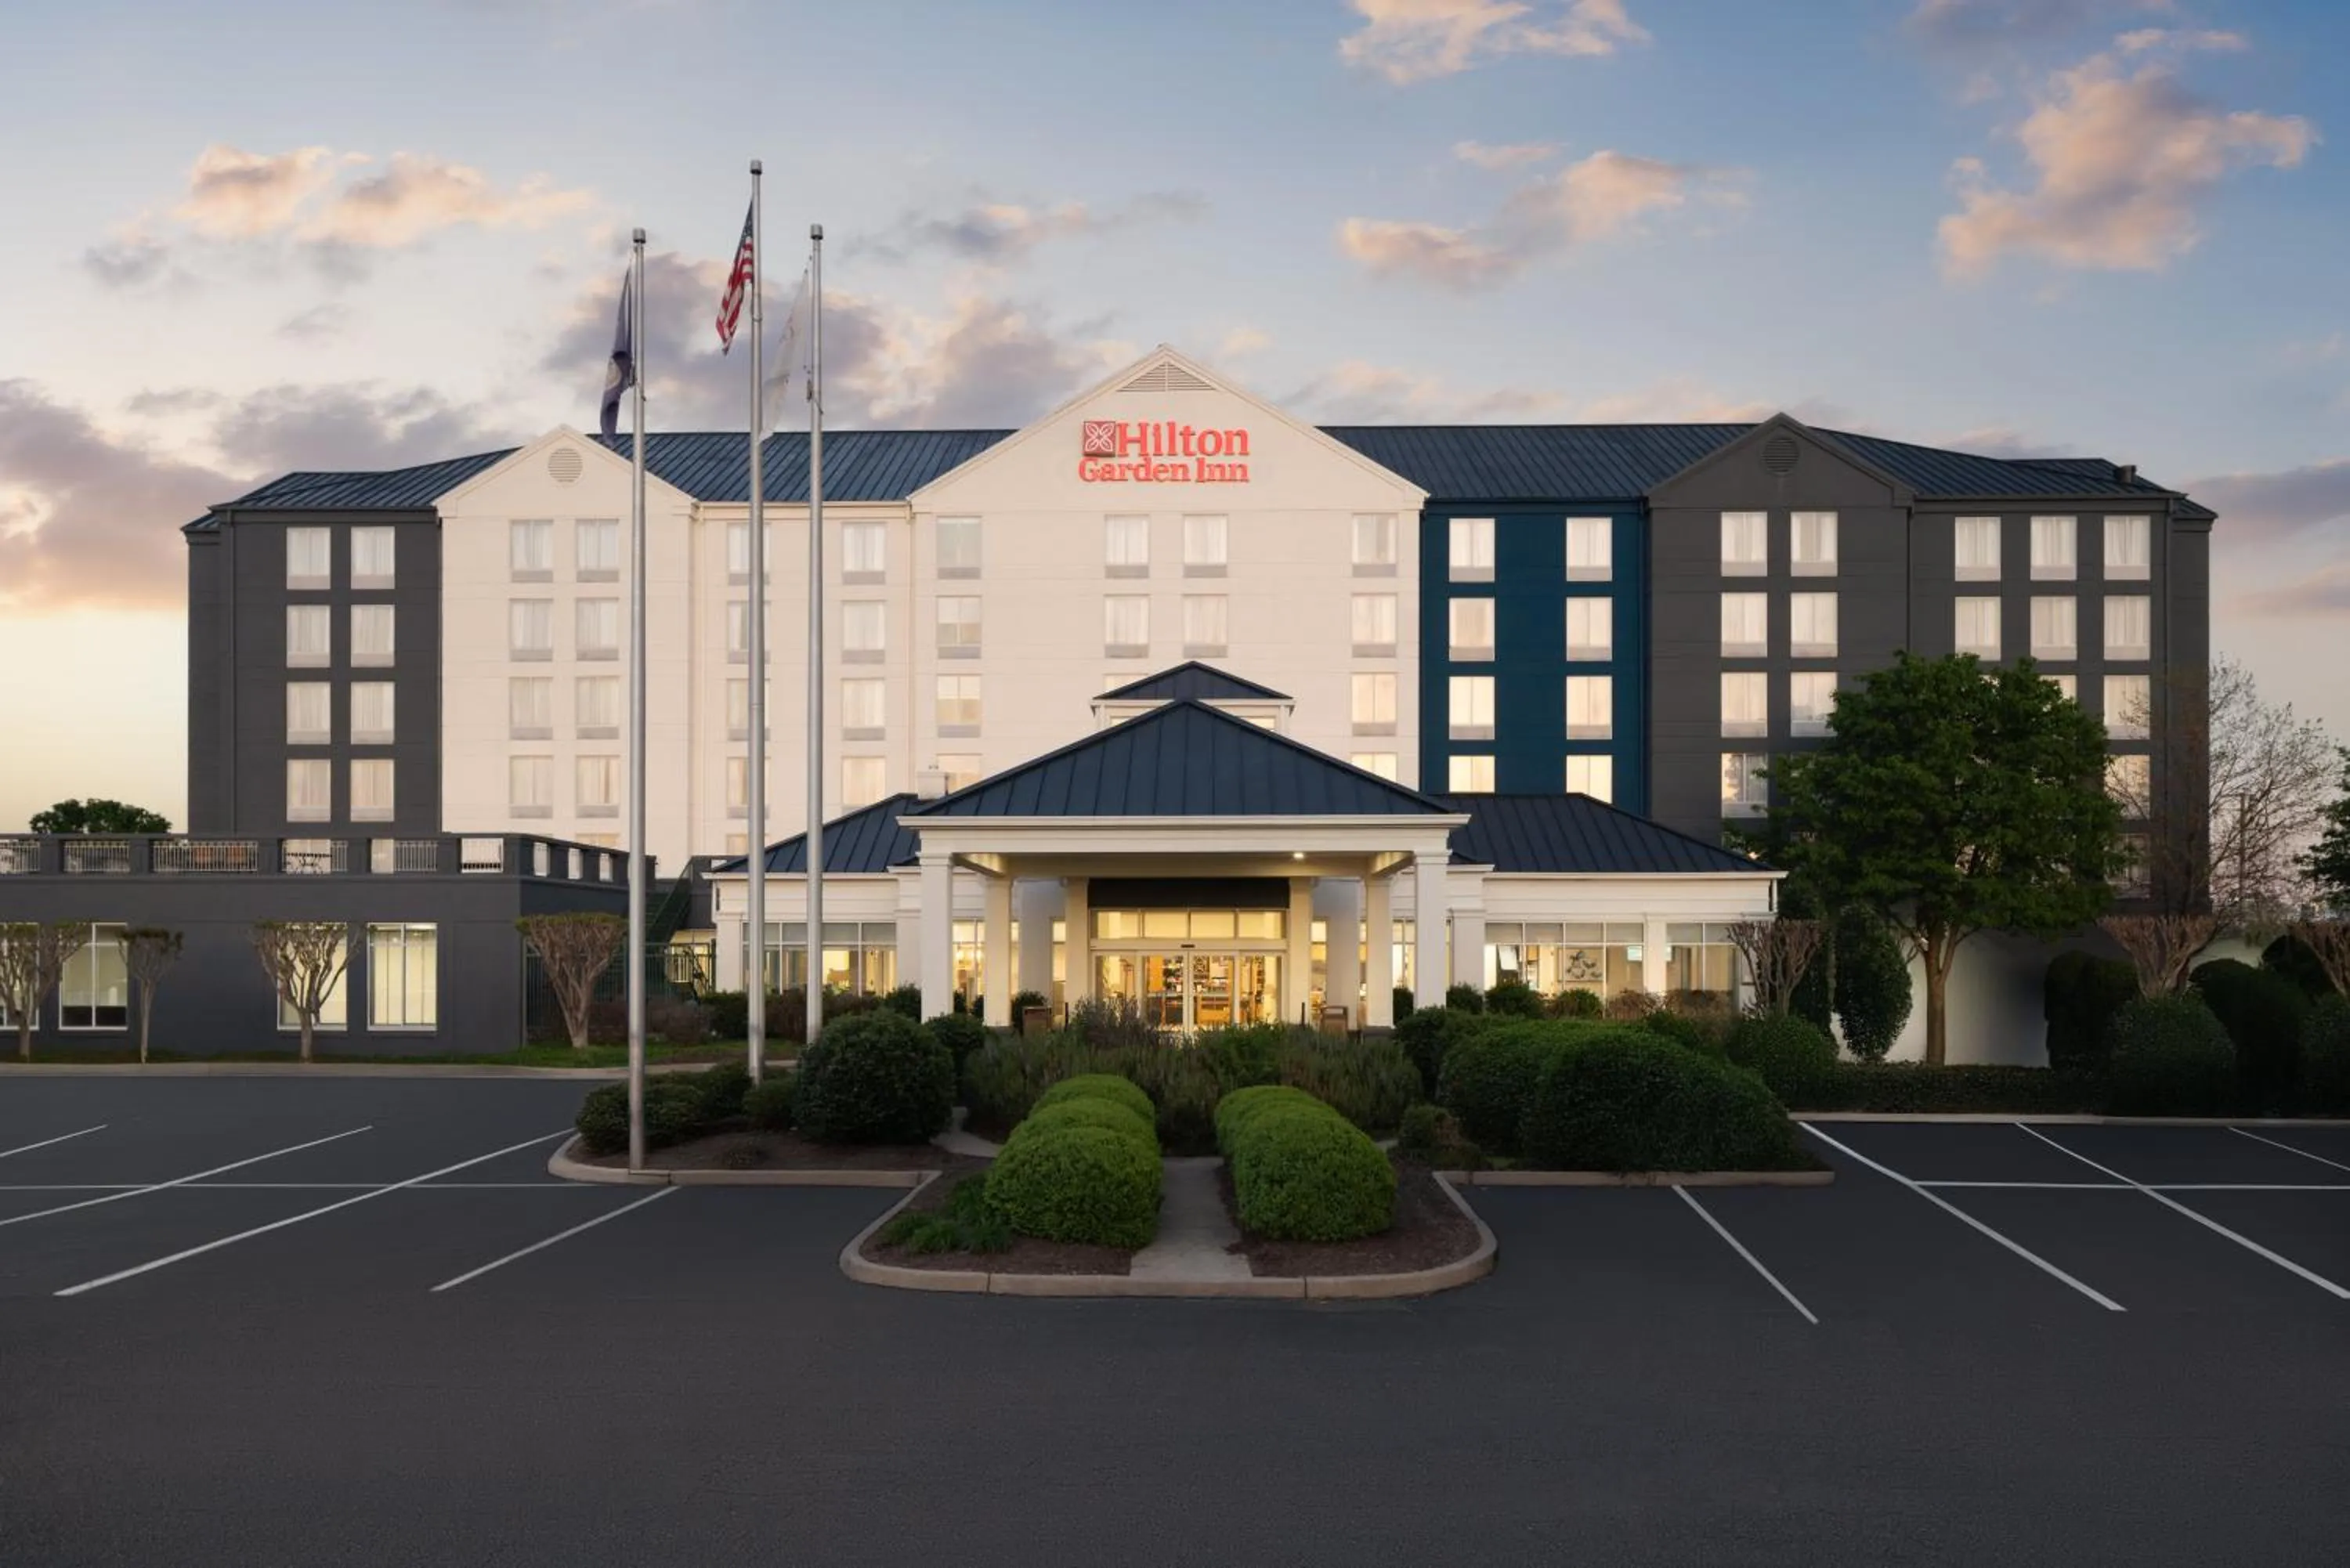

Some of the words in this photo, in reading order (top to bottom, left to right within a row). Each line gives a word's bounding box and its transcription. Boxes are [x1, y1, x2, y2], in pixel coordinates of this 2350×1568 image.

[1116, 420, 1250, 457] Hilton
[1078, 457, 1191, 482] Garden
[1195, 457, 1250, 483] Inn
